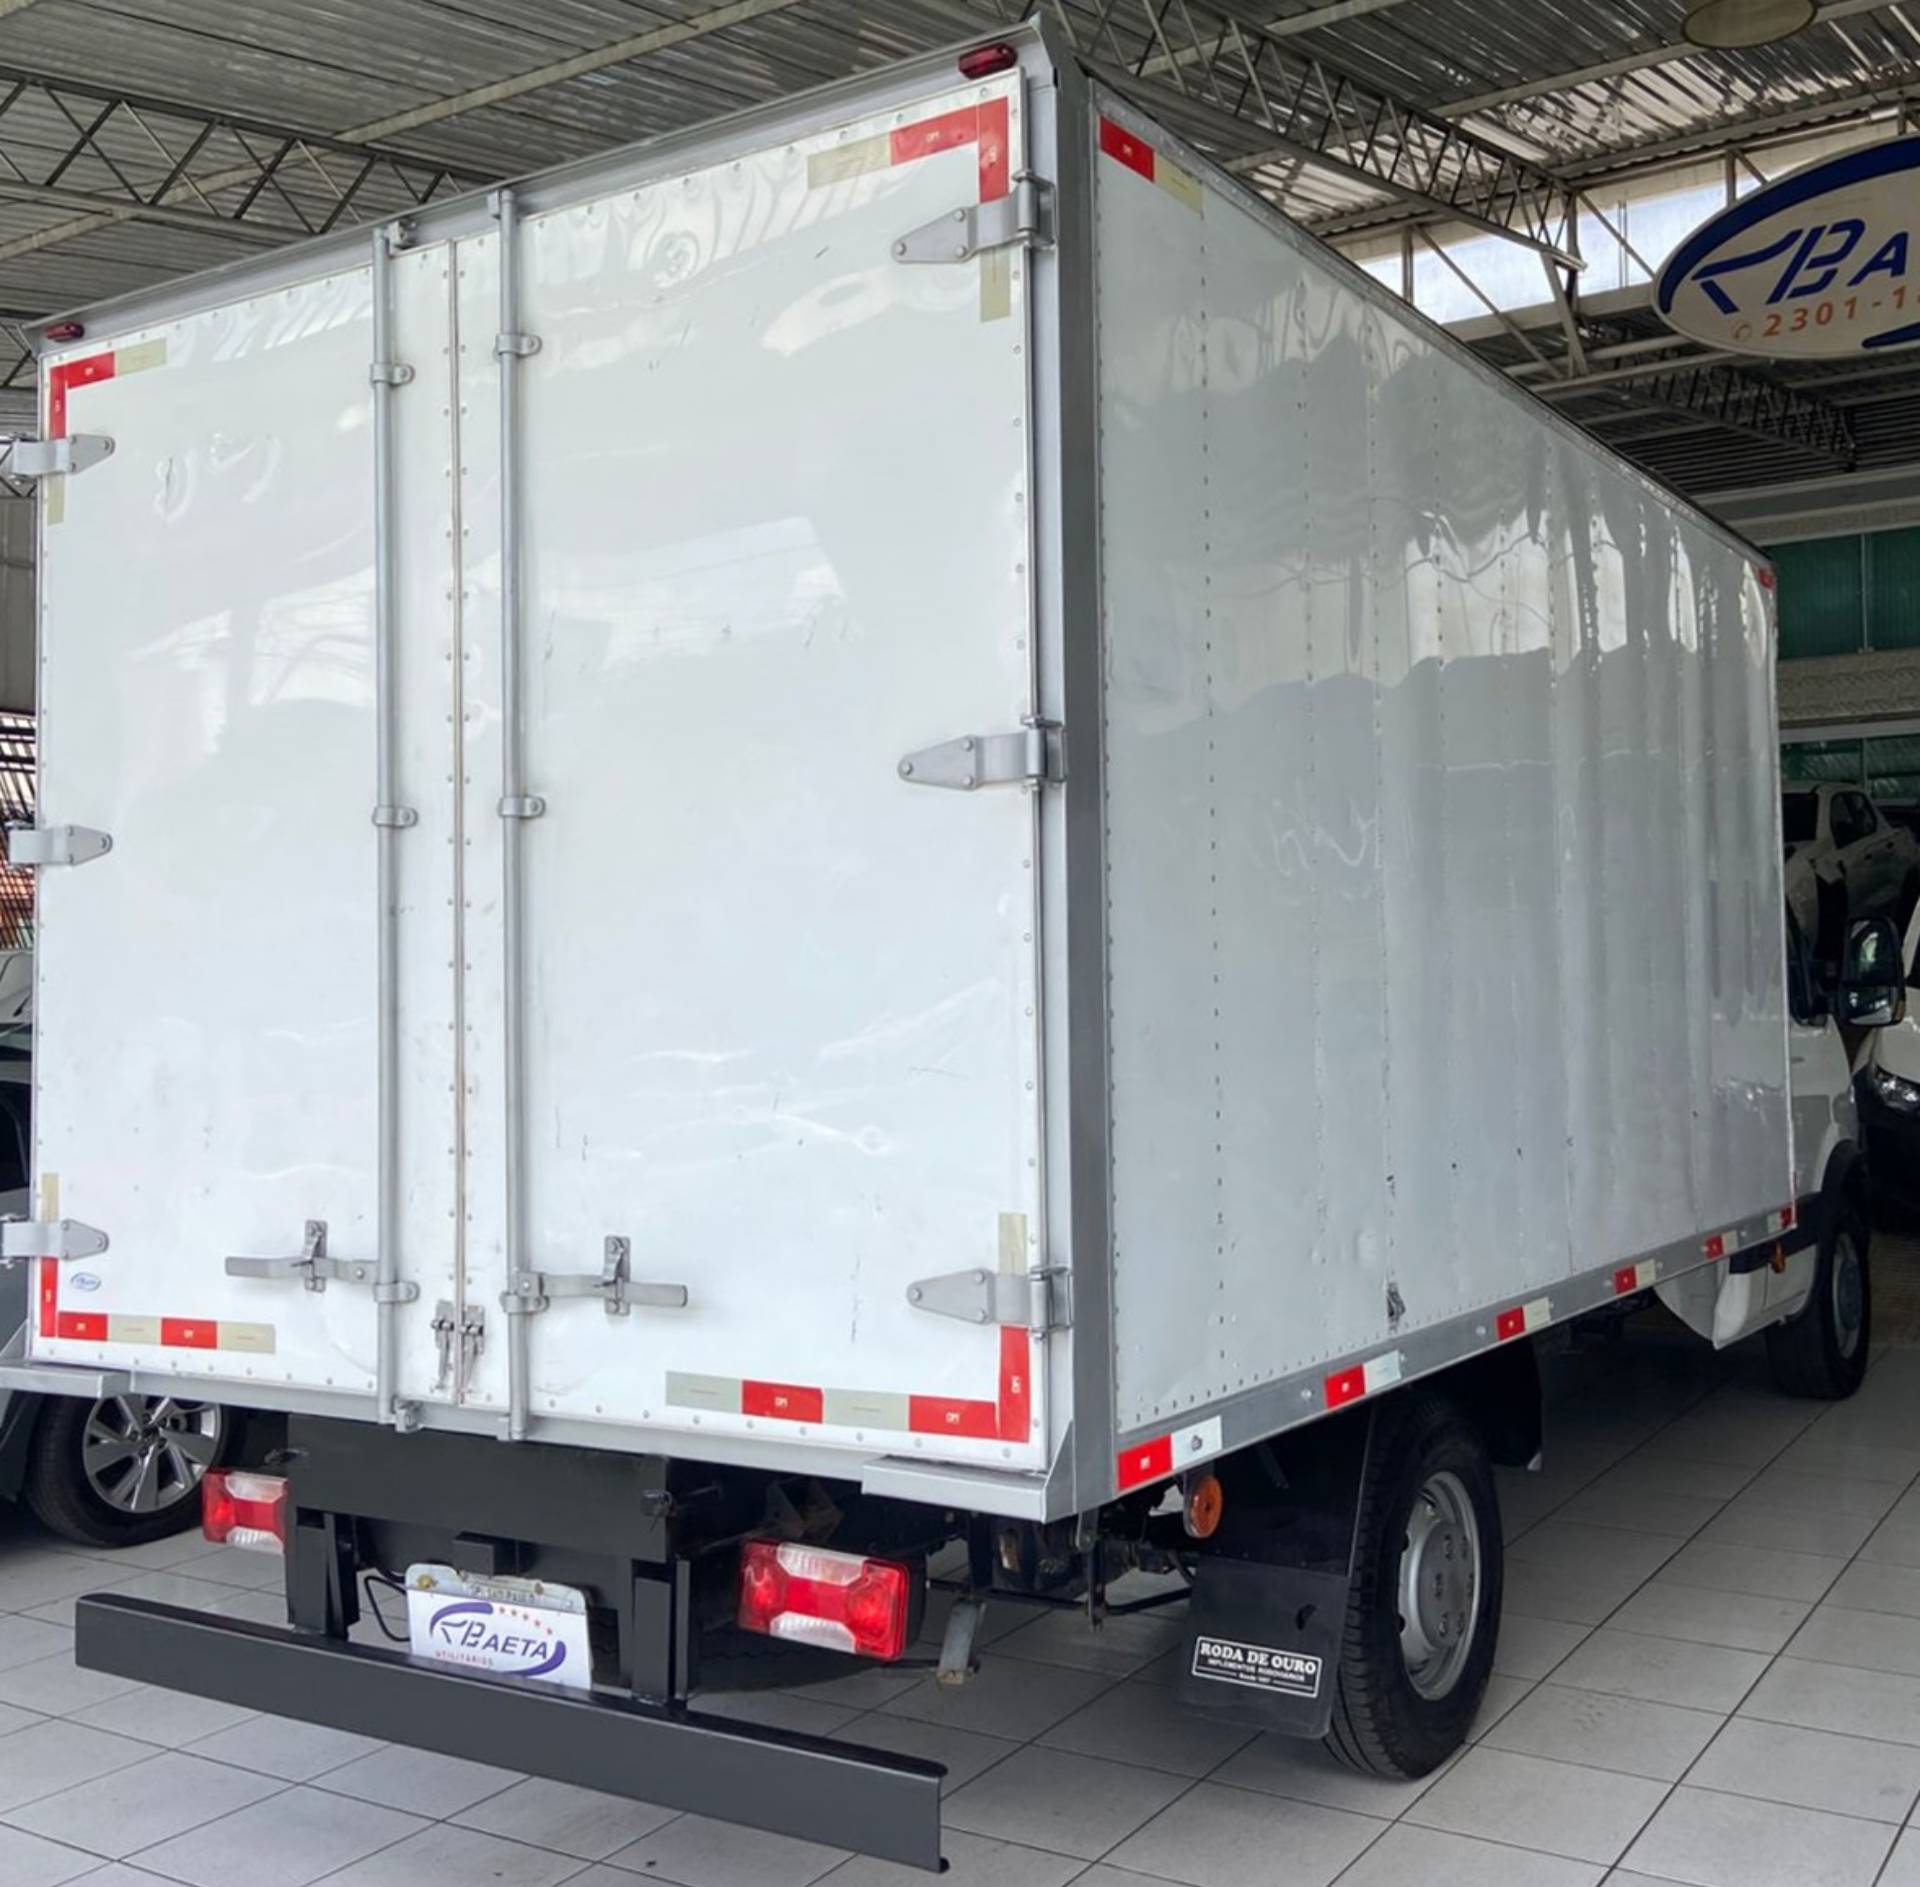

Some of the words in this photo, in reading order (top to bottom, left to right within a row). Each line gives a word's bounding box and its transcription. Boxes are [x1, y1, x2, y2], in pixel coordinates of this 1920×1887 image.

[1763, 284, 1920, 337] 2301-1
[460, 1620, 548, 1660] BAETA
[1200, 1642, 1243, 1662] RODA
[1246, 1650, 1269, 1666] DE
[1270, 1655, 1317, 1675] OURO
